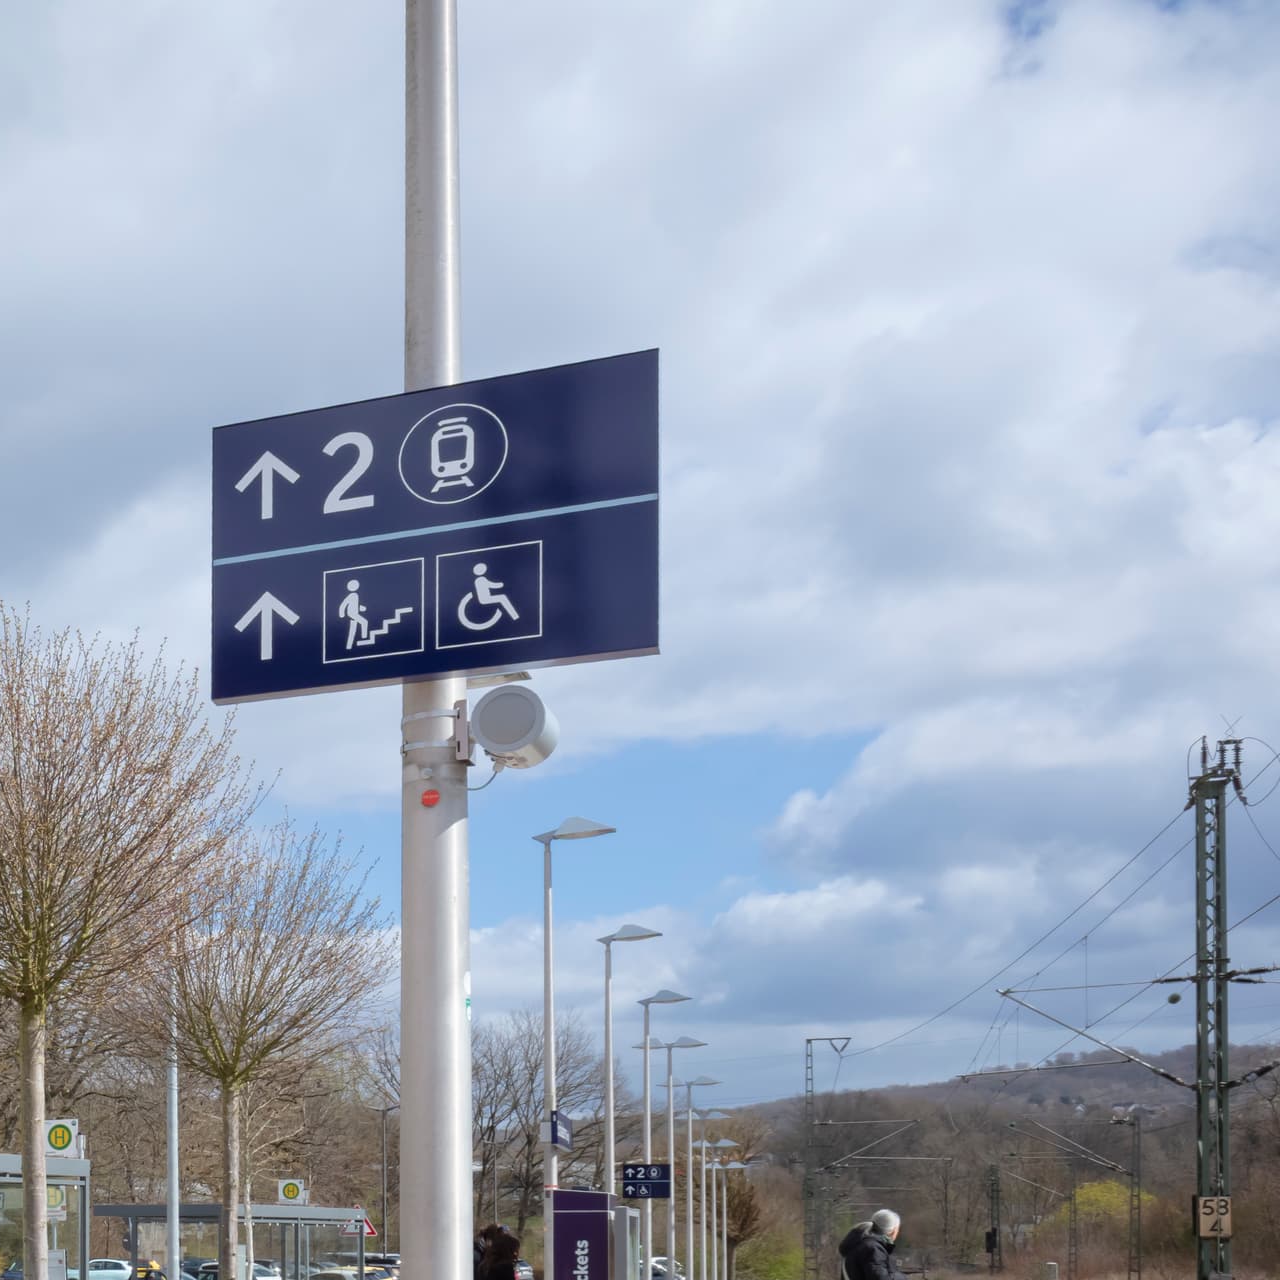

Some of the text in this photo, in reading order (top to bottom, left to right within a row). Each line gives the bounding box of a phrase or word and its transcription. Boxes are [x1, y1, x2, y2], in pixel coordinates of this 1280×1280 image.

[321, 430, 375, 515] 2
[54, 1130, 64, 1145] H
[636, 1167, 645, 1178] 2
[1202, 1199, 1229, 1216] 58
[1209, 1219, 1224, 1235] 4
